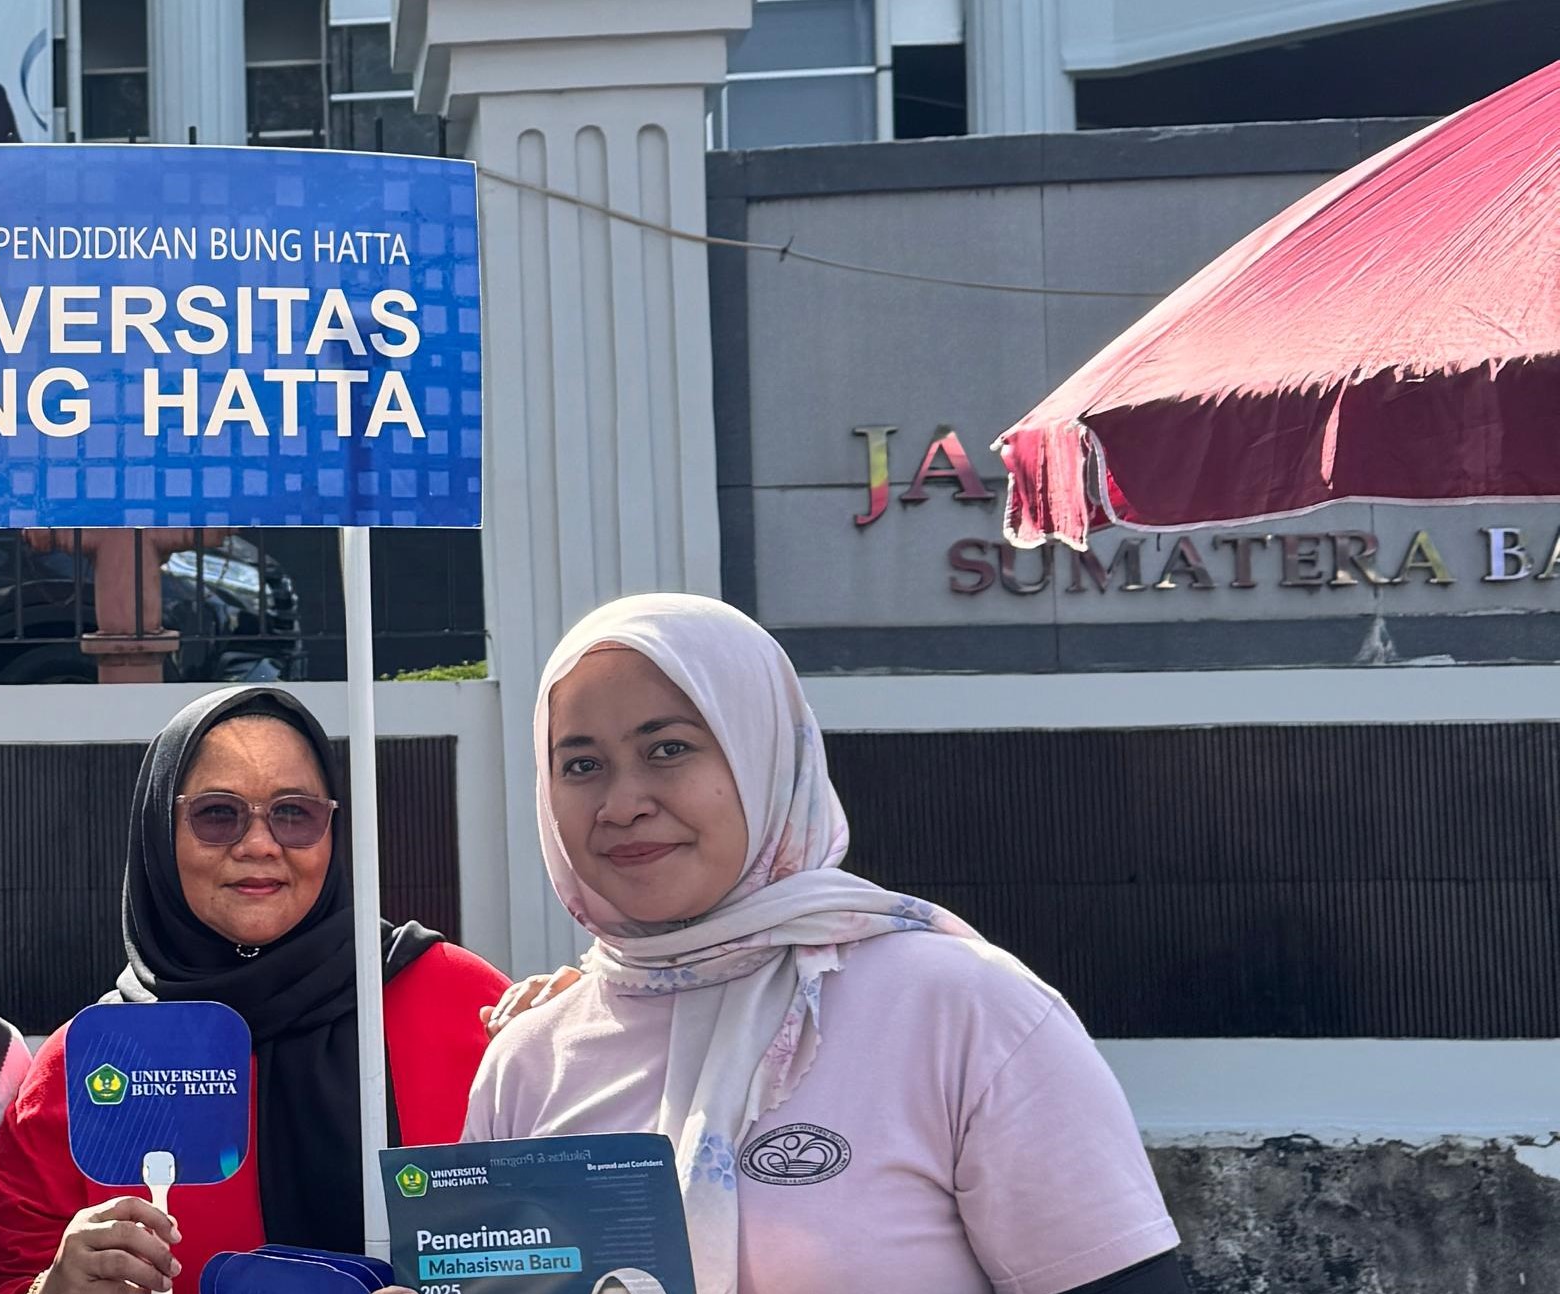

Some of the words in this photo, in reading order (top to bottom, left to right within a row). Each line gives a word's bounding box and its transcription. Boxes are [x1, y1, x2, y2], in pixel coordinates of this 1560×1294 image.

[209, 229, 303, 263] BUNG
[314, 231, 410, 265] HATTA
[144, 369, 426, 439] HATTA
[947, 529, 1455, 596] SUMATERA
[131, 1069, 237, 1083] UNIVERSITAS
[131, 1082, 177, 1097] BUNG
[184, 1081, 237, 1096] HATTA
[430, 1167, 487, 1178] UNIVERSITAS
[432, 1178, 458, 1188] BUNG
[459, 1176, 488, 1186] HATTA
[417, 1226, 551, 1252] Penerimaan
[428, 1256, 524, 1276] Mahasiswa
[529, 1254, 571, 1270] Baru
